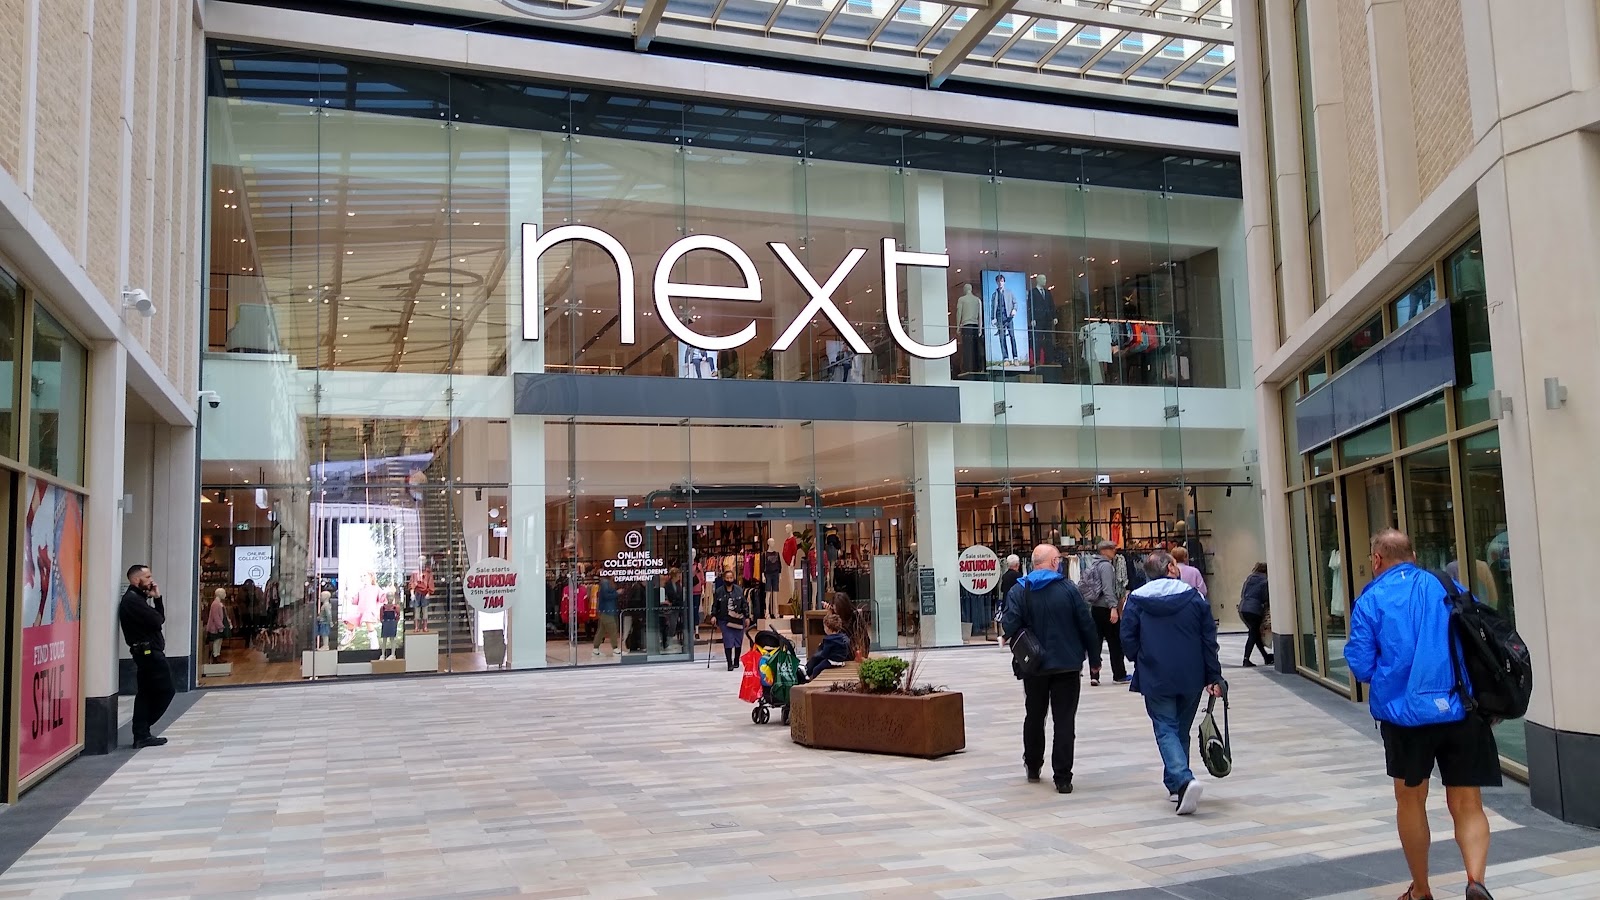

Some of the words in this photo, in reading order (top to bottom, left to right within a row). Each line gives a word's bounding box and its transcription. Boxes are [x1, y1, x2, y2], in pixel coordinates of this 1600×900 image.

[520, 222, 958, 360] next
[617, 550, 651, 560] ONLINE
[604, 558, 664, 568] COLLECTIONS
[959, 559, 997, 573] SATURDAY
[475, 566, 491, 574] Sale
[599, 569, 627, 577] LOCATED
[634, 568, 668, 576] CHILDREN'S
[466, 573, 518, 589] SATURDAY
[614, 575, 654, 583] DEPARTMENT
[971, 579, 988, 590] 7AM
[484, 588, 517, 597] September
[482, 595, 504, 609] 7AM
[33, 643, 49, 666] FIND
[49, 640, 65, 662] YOUR
[31, 664, 65, 740] STYLE
